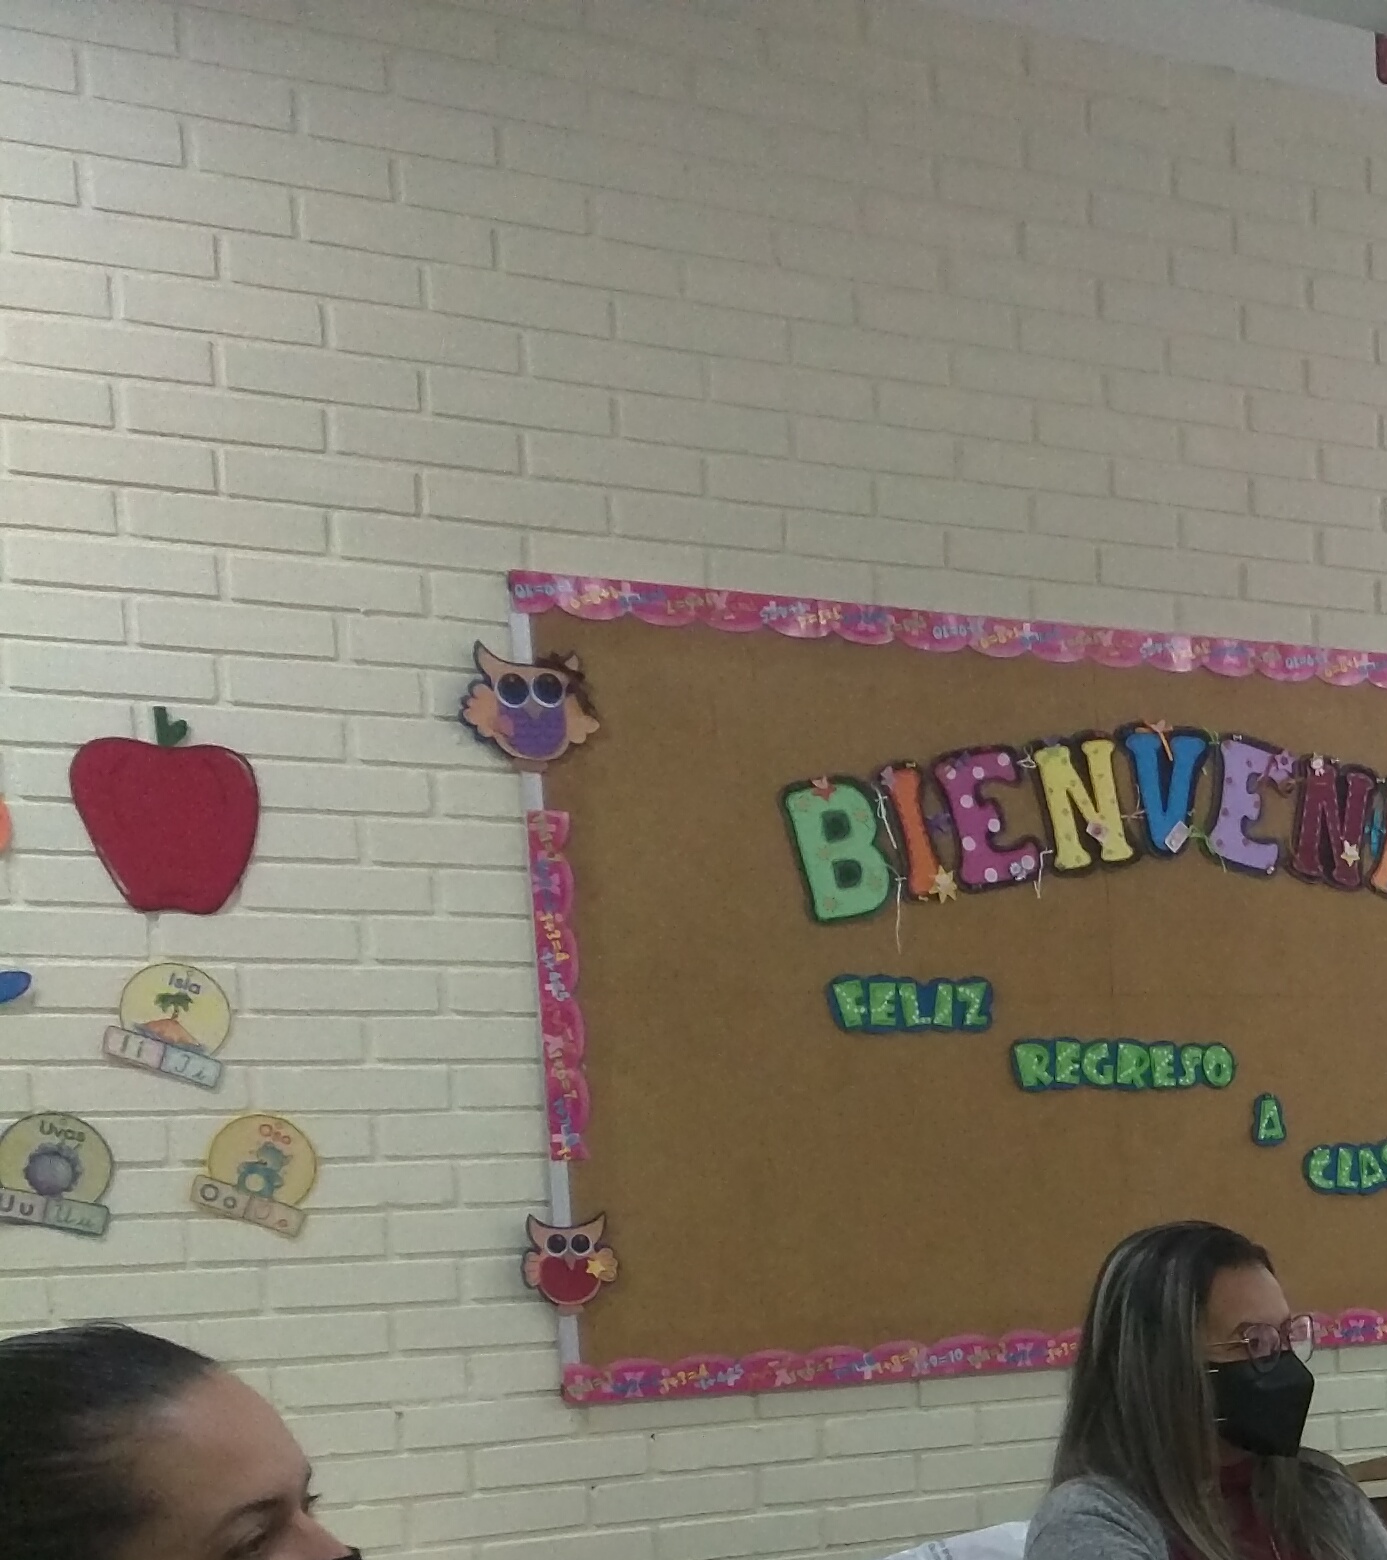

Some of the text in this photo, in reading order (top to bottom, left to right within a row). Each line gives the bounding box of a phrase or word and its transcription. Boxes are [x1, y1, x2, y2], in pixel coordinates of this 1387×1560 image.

[168, 972, 201, 995] Isla
[831, 978, 992, 1031] FELIZ
[1013, 1041, 1235, 1089] REGRESO
[40, 1120, 86, 1143] Uvas
[259, 1123, 292, 1146] Oso
[1255, 1096, 1285, 1143] A
